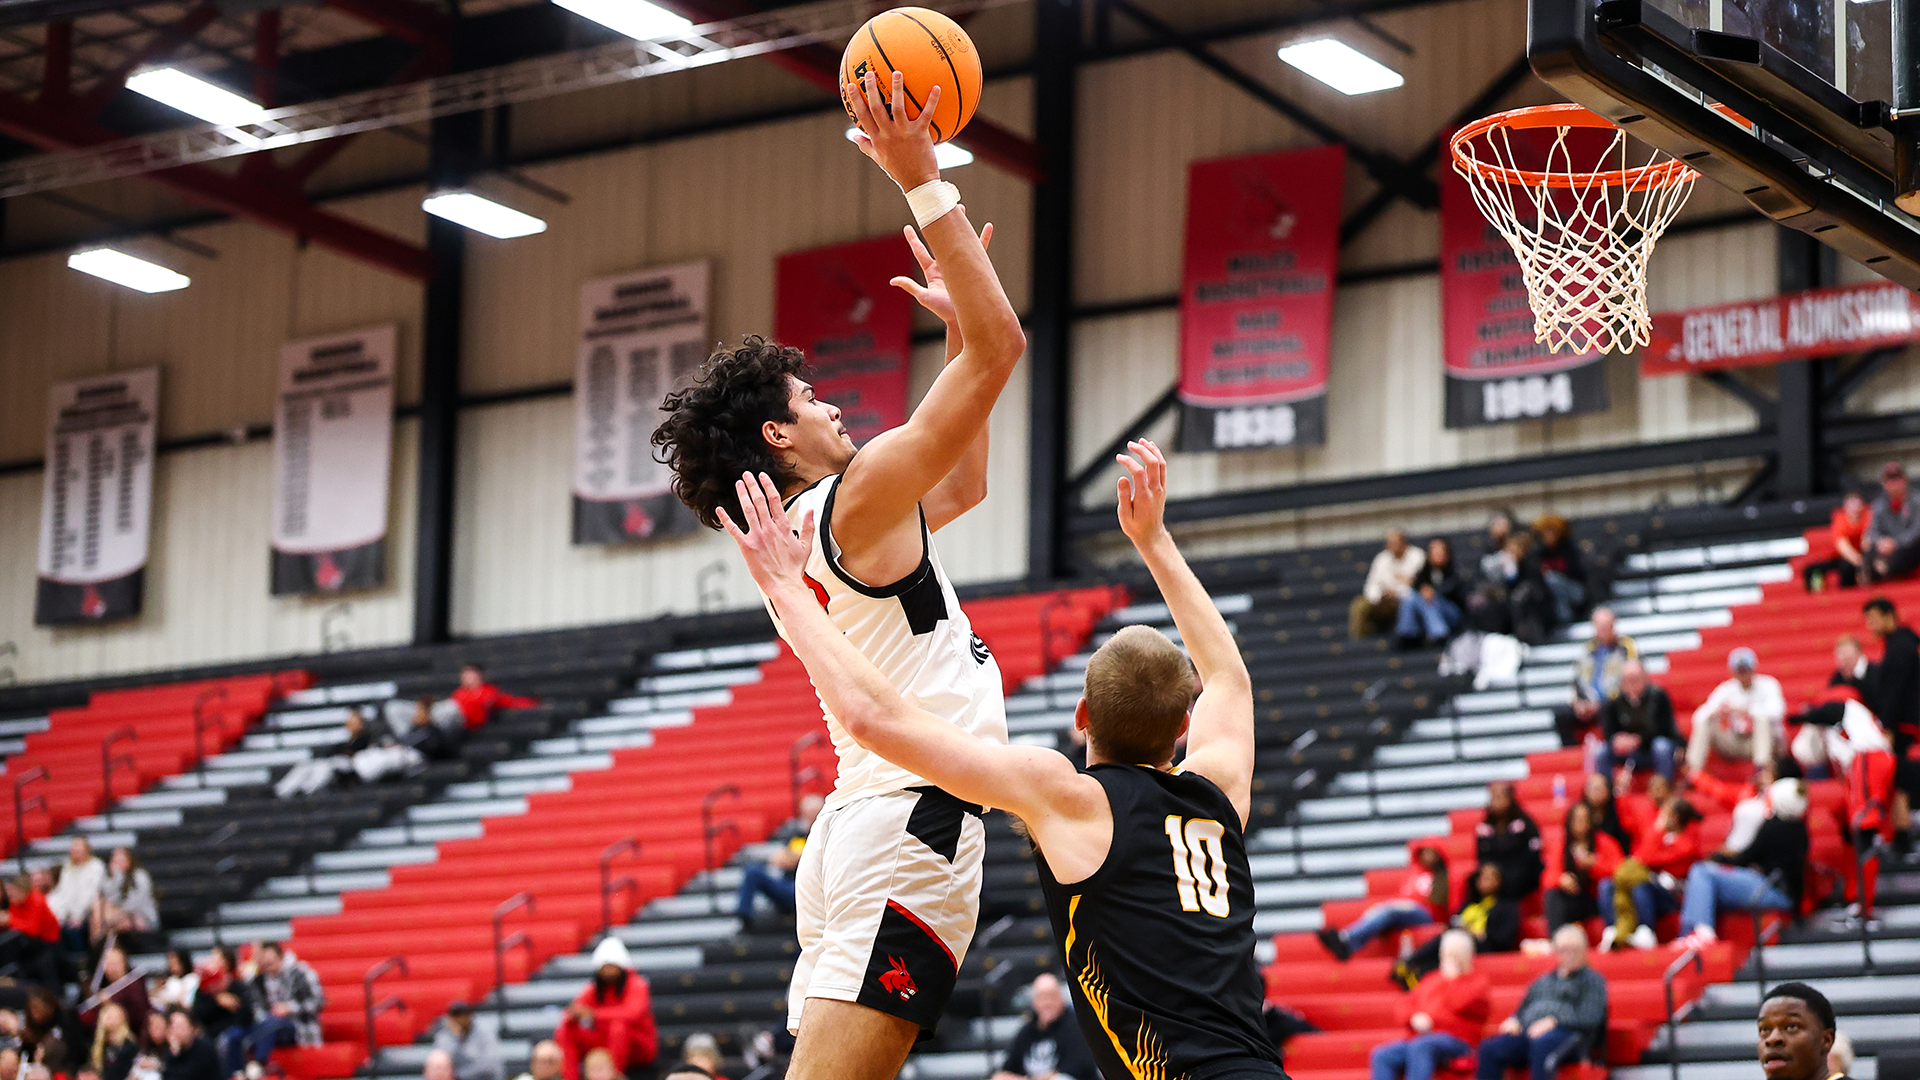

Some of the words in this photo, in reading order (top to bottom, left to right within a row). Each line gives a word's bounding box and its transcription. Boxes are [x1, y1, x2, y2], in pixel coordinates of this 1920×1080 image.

[1683, 303, 1783, 364] GENERAL
[1787, 286, 1913, 347] ADMISSION
[1482, 373, 1573, 420] 1984
[1164, 814, 1231, 918] 10
